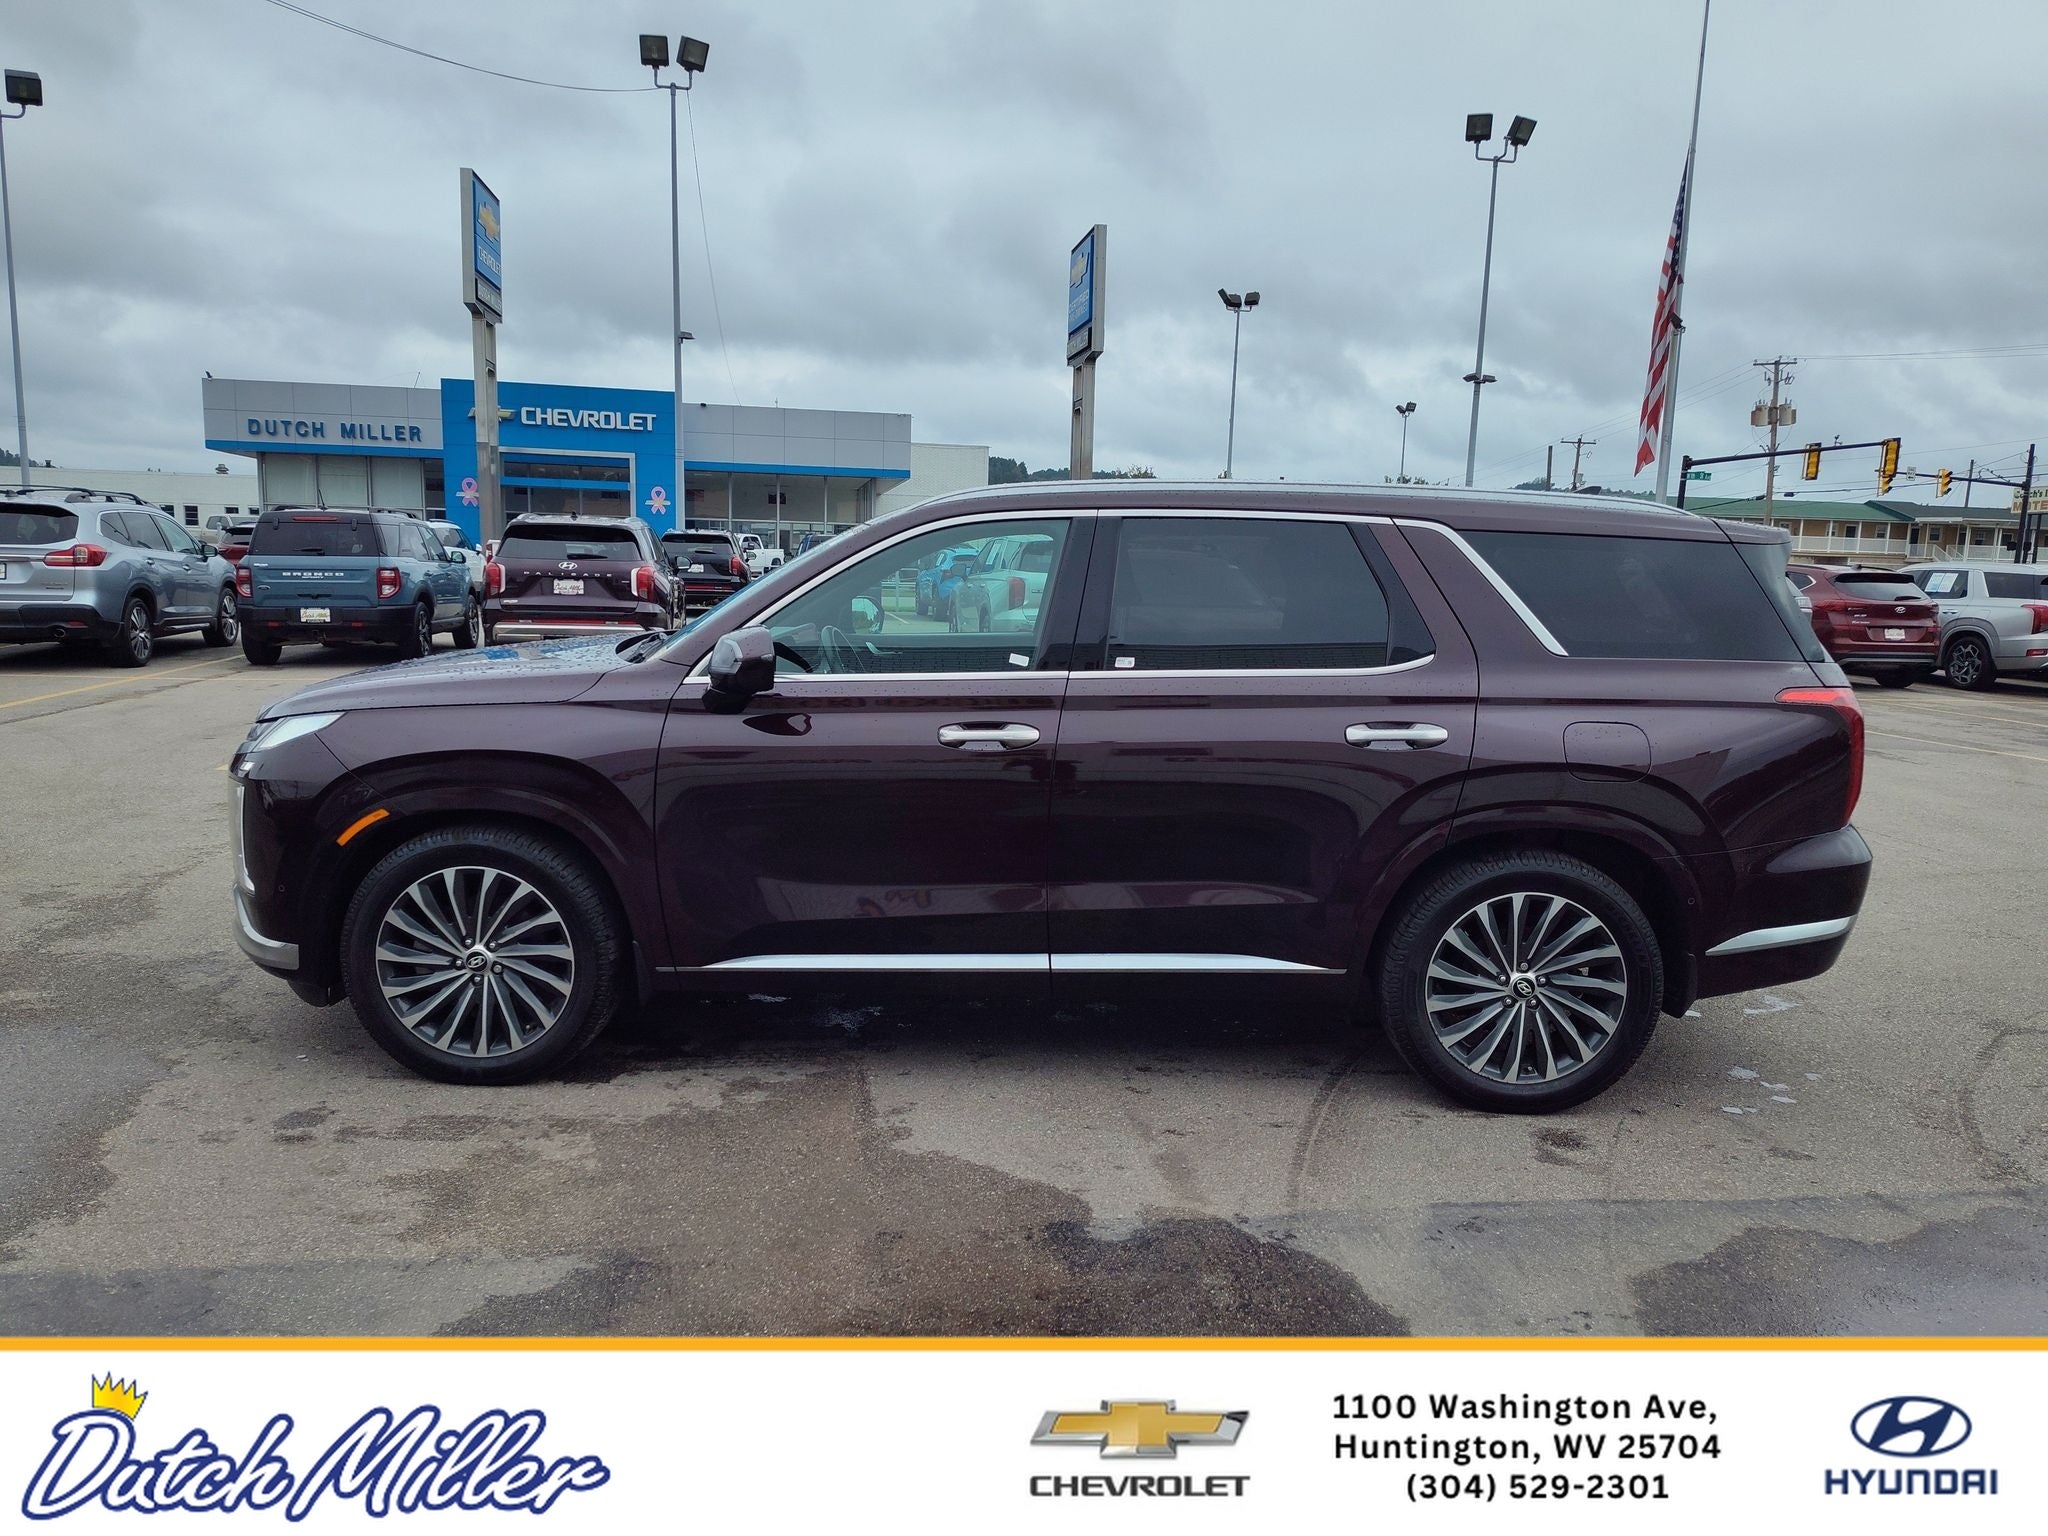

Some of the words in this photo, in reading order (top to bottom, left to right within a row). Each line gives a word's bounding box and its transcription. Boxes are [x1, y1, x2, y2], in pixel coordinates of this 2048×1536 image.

[247, 418, 326, 439] DUTCH
[340, 422, 423, 443] MILLER
[520, 406, 657, 431] CHEVROLET
